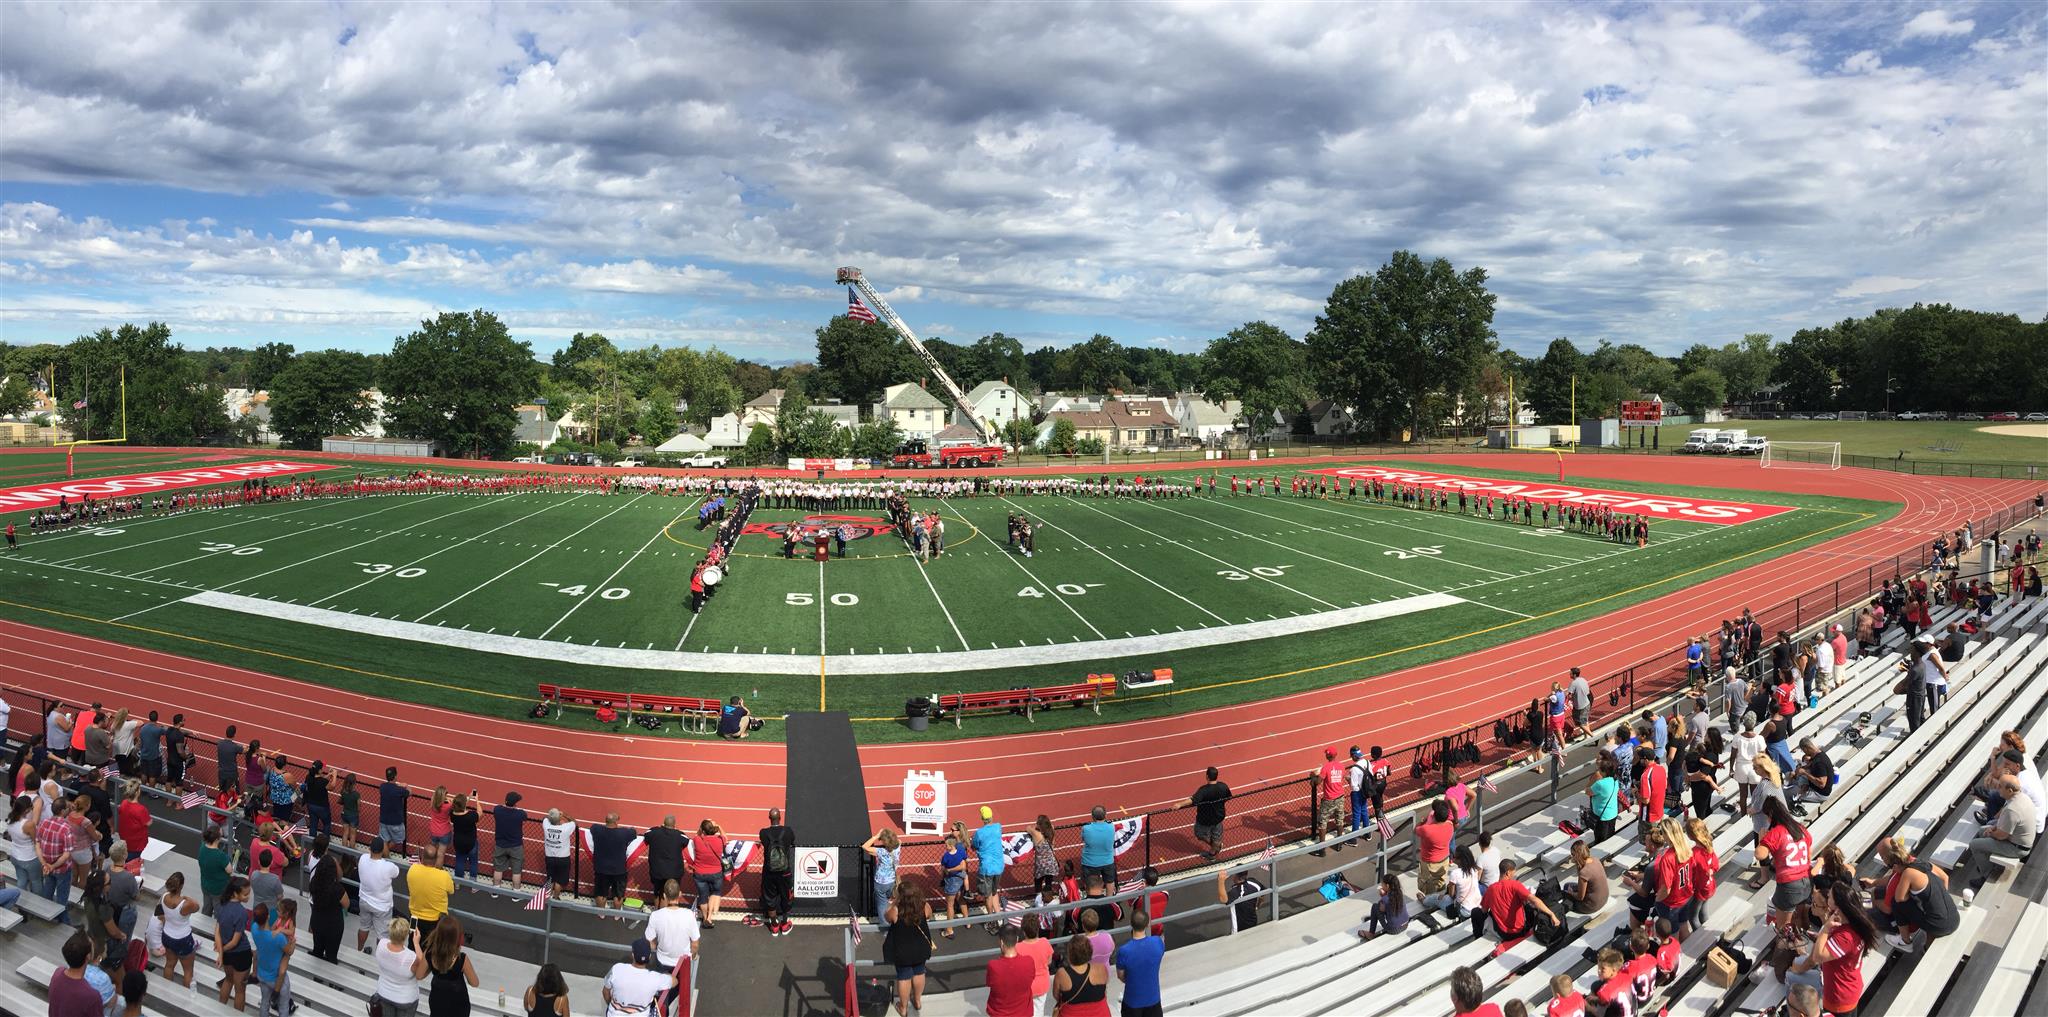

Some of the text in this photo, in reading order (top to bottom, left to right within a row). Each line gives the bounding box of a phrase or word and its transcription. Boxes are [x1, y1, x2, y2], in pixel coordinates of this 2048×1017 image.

[1336, 468, 1752, 518] CRUSADERS
[1383, 547, 1442, 560] 20
[361, 563, 427, 578] 30
[1216, 566, 1285, 581] 30
[557, 584, 631, 600] 40
[1017, 583, 1087, 598] 40
[785, 592, 859, 606] 50
[914, 790, 935, 800] STOP
[1786, 841, 1808, 867] 23
